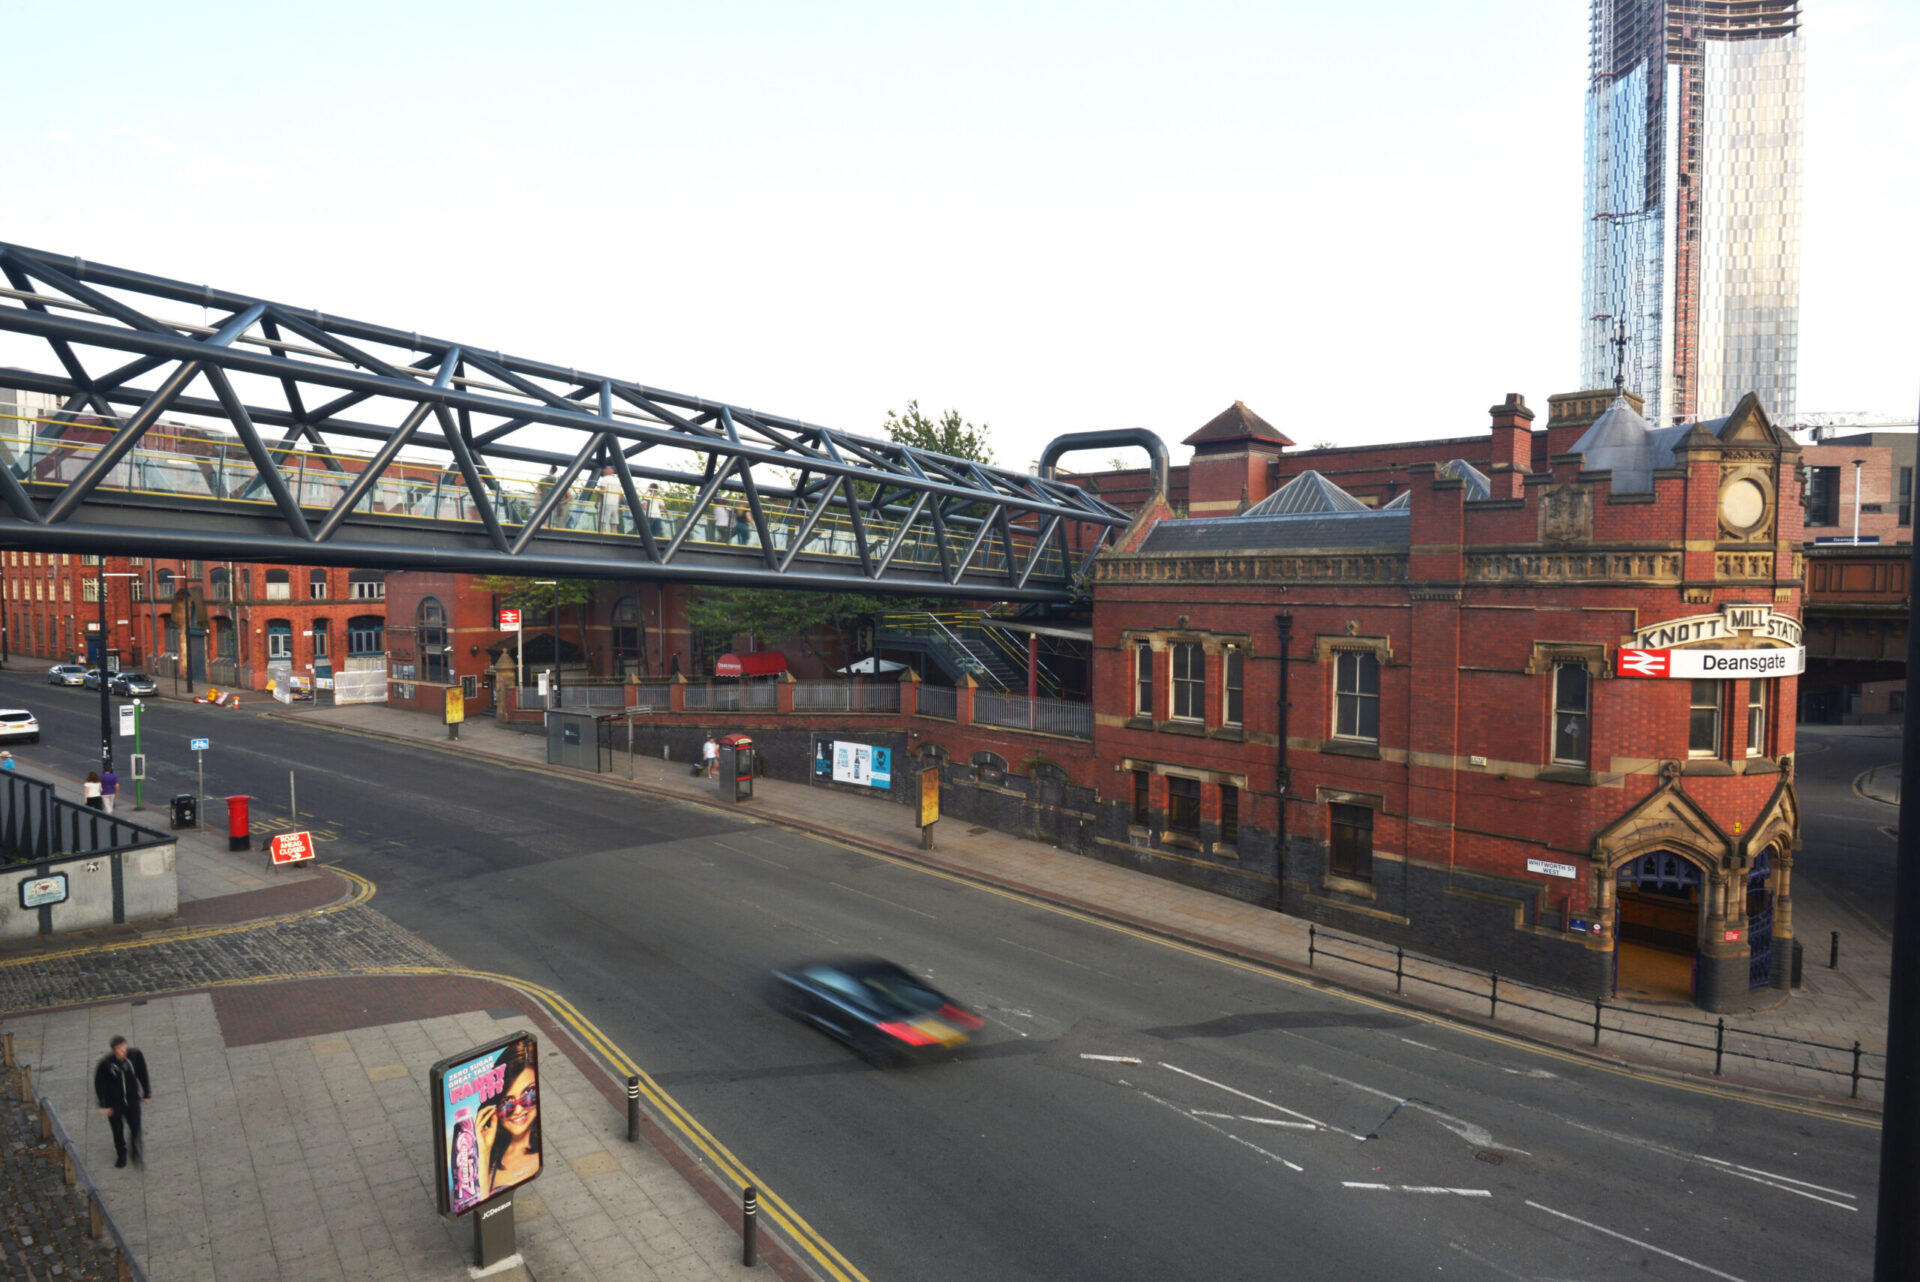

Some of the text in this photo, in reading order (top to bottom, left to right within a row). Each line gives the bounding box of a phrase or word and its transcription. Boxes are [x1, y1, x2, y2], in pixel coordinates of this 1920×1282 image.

[1642, 619, 1720, 649] KNOTT
[1731, 610, 1766, 628] MILL
[1703, 654, 1785, 672] Deansgate
[280, 834, 299, 842] ROAD
[280, 840, 302, 849] AHEAD
[279, 846, 306, 855] CLOSED
[1529, 860, 1566, 870] WHITWORTH
[1543, 867, 1559, 875] WEST
[448, 1056, 493, 1081] ZERO SUGAR
[448, 1062, 495, 1088] GREAT TASTE
[481, 1200, 512, 1220] JCDecaux
